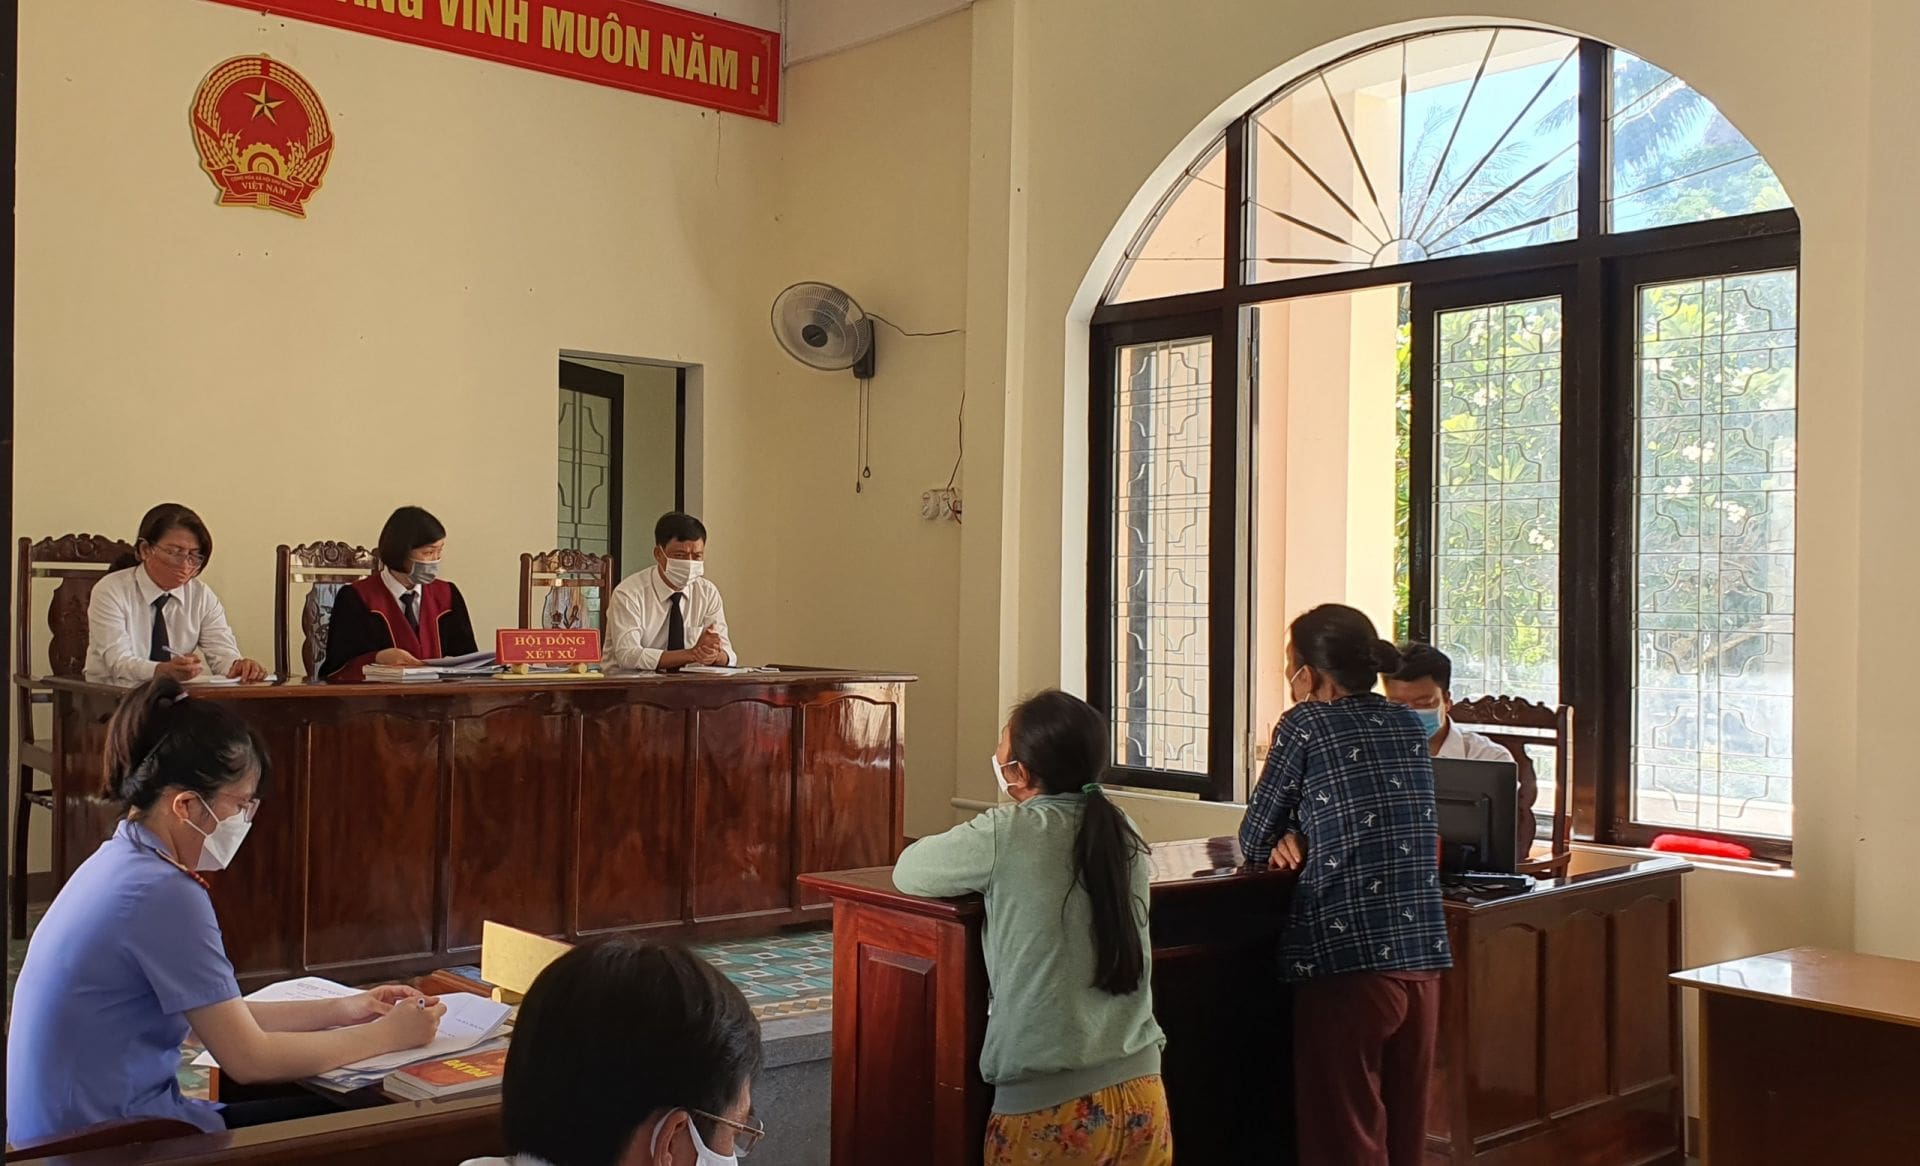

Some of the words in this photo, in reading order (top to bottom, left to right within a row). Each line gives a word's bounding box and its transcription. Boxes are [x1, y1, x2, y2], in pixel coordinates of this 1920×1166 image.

[439, 0, 529, 43] VINH
[541, 8, 650, 71] MUÔN
[661, 32, 739, 90] NĂM
[751, 55, 760, 95] !
[241, 180, 265, 191] VIỆT
[265, 184, 287, 197] NAM
[515, 634, 541, 647] HỘI
[526, 648, 554, 659] XÉT
[557, 647, 577, 659] XỬ
